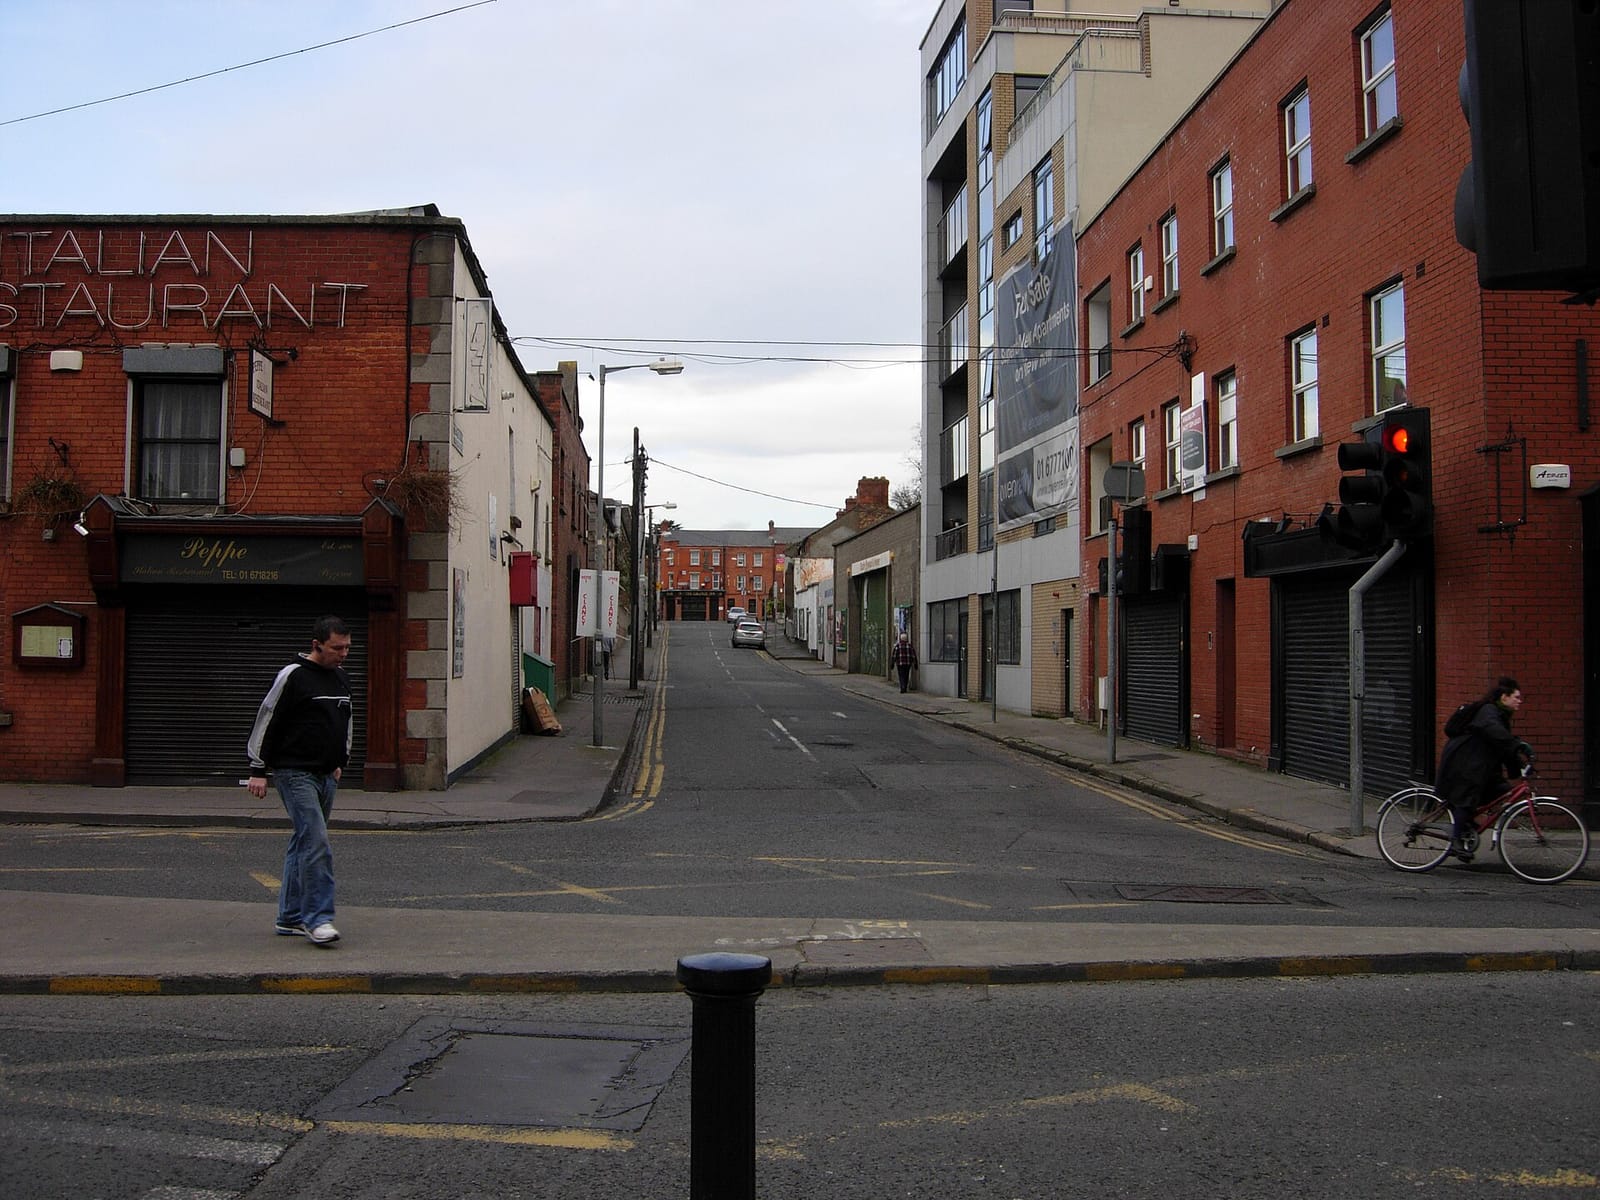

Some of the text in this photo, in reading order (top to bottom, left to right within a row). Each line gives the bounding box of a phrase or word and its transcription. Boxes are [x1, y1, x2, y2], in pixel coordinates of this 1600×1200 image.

[0, 229, 253, 276] TALIAN
[1015, 273, 1051, 319] For Sale
[1033, 302, 1070, 344] Apartments
[181, 537, 248, 567] Peppe
[239, 569, 248, 580] 01
